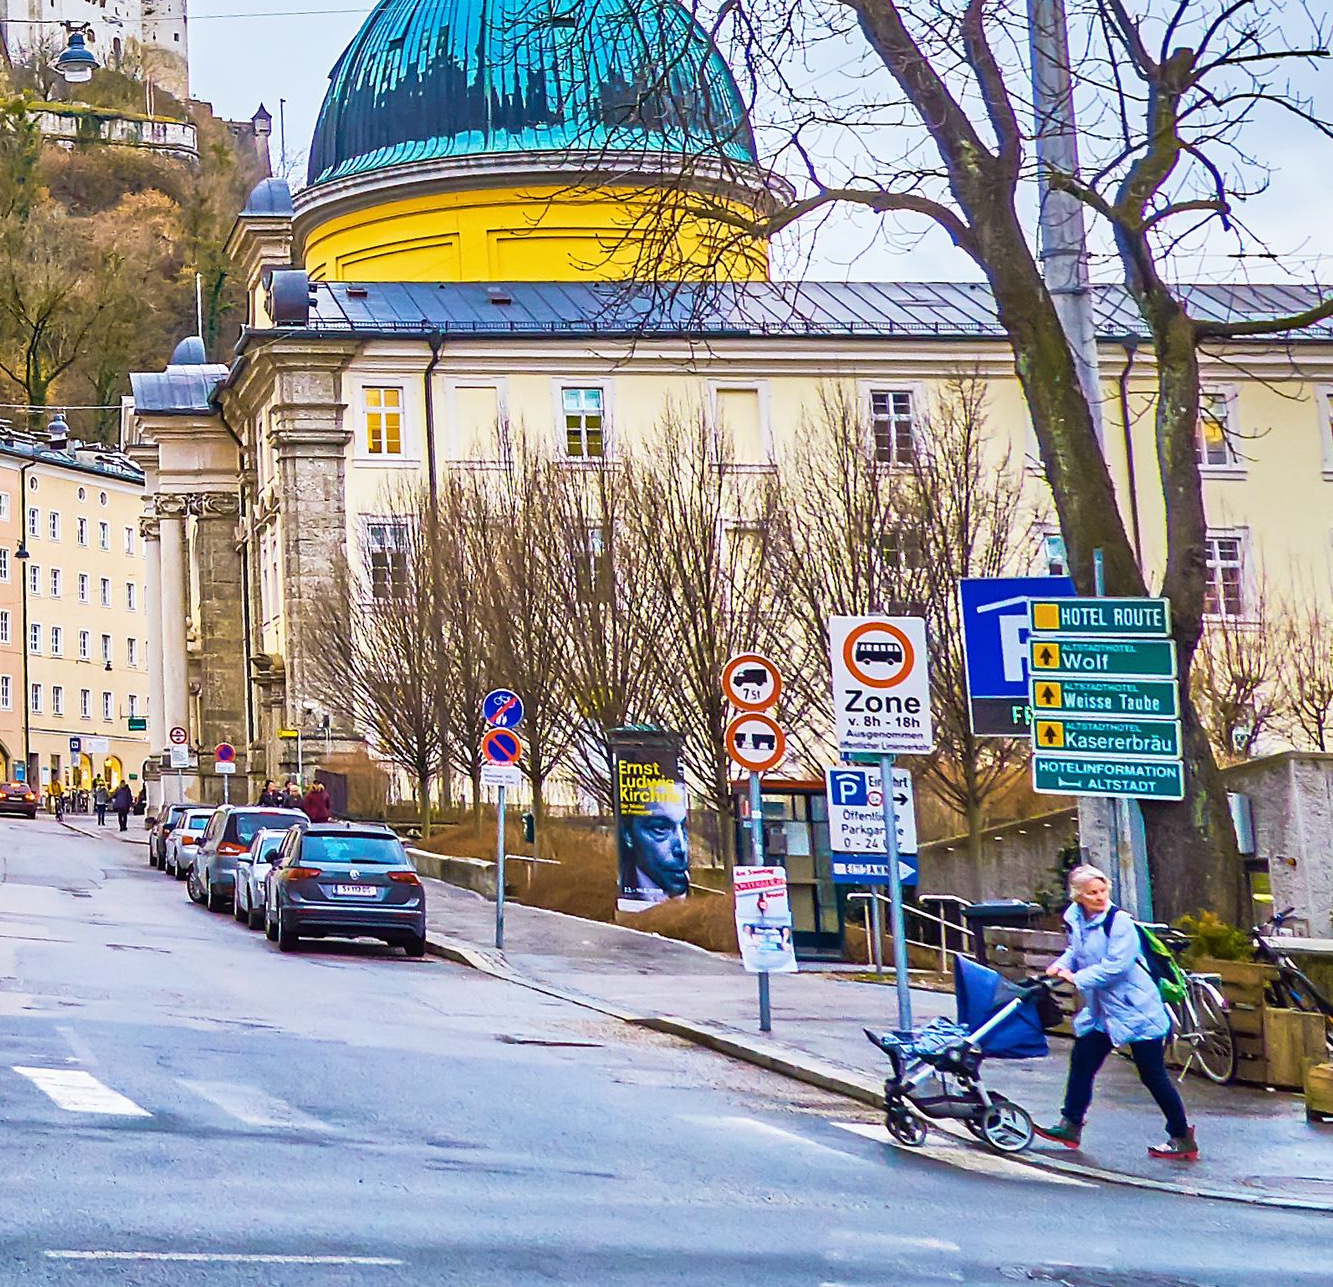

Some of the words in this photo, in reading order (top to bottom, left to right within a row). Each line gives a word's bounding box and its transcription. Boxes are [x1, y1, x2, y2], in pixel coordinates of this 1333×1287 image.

[1061, 608, 1107, 626] HOTEL
[1114, 608, 1162, 626] ROUTE
[1062, 653, 1109, 670] Wolf
[845, 690, 921, 714] Zone
[1064, 693, 1112, 709] Weisse
[1119, 694, 1160, 711] Taube
[848, 718, 859, 726] v.
[864, 716, 881, 727] 8h
[896, 717, 920, 728] 18h
[846, 729, 923, 739] Ausgenommen
[1065, 732, 1172, 752] Kasererbräu
[619, 760, 660, 775] Ernst
[1039, 762, 1176, 777] HOTELINFORMATION
[1088, 780, 1156, 792] ALTSTADT
[844, 837, 851, 848] 0
[865, 838, 879, 849] 24
